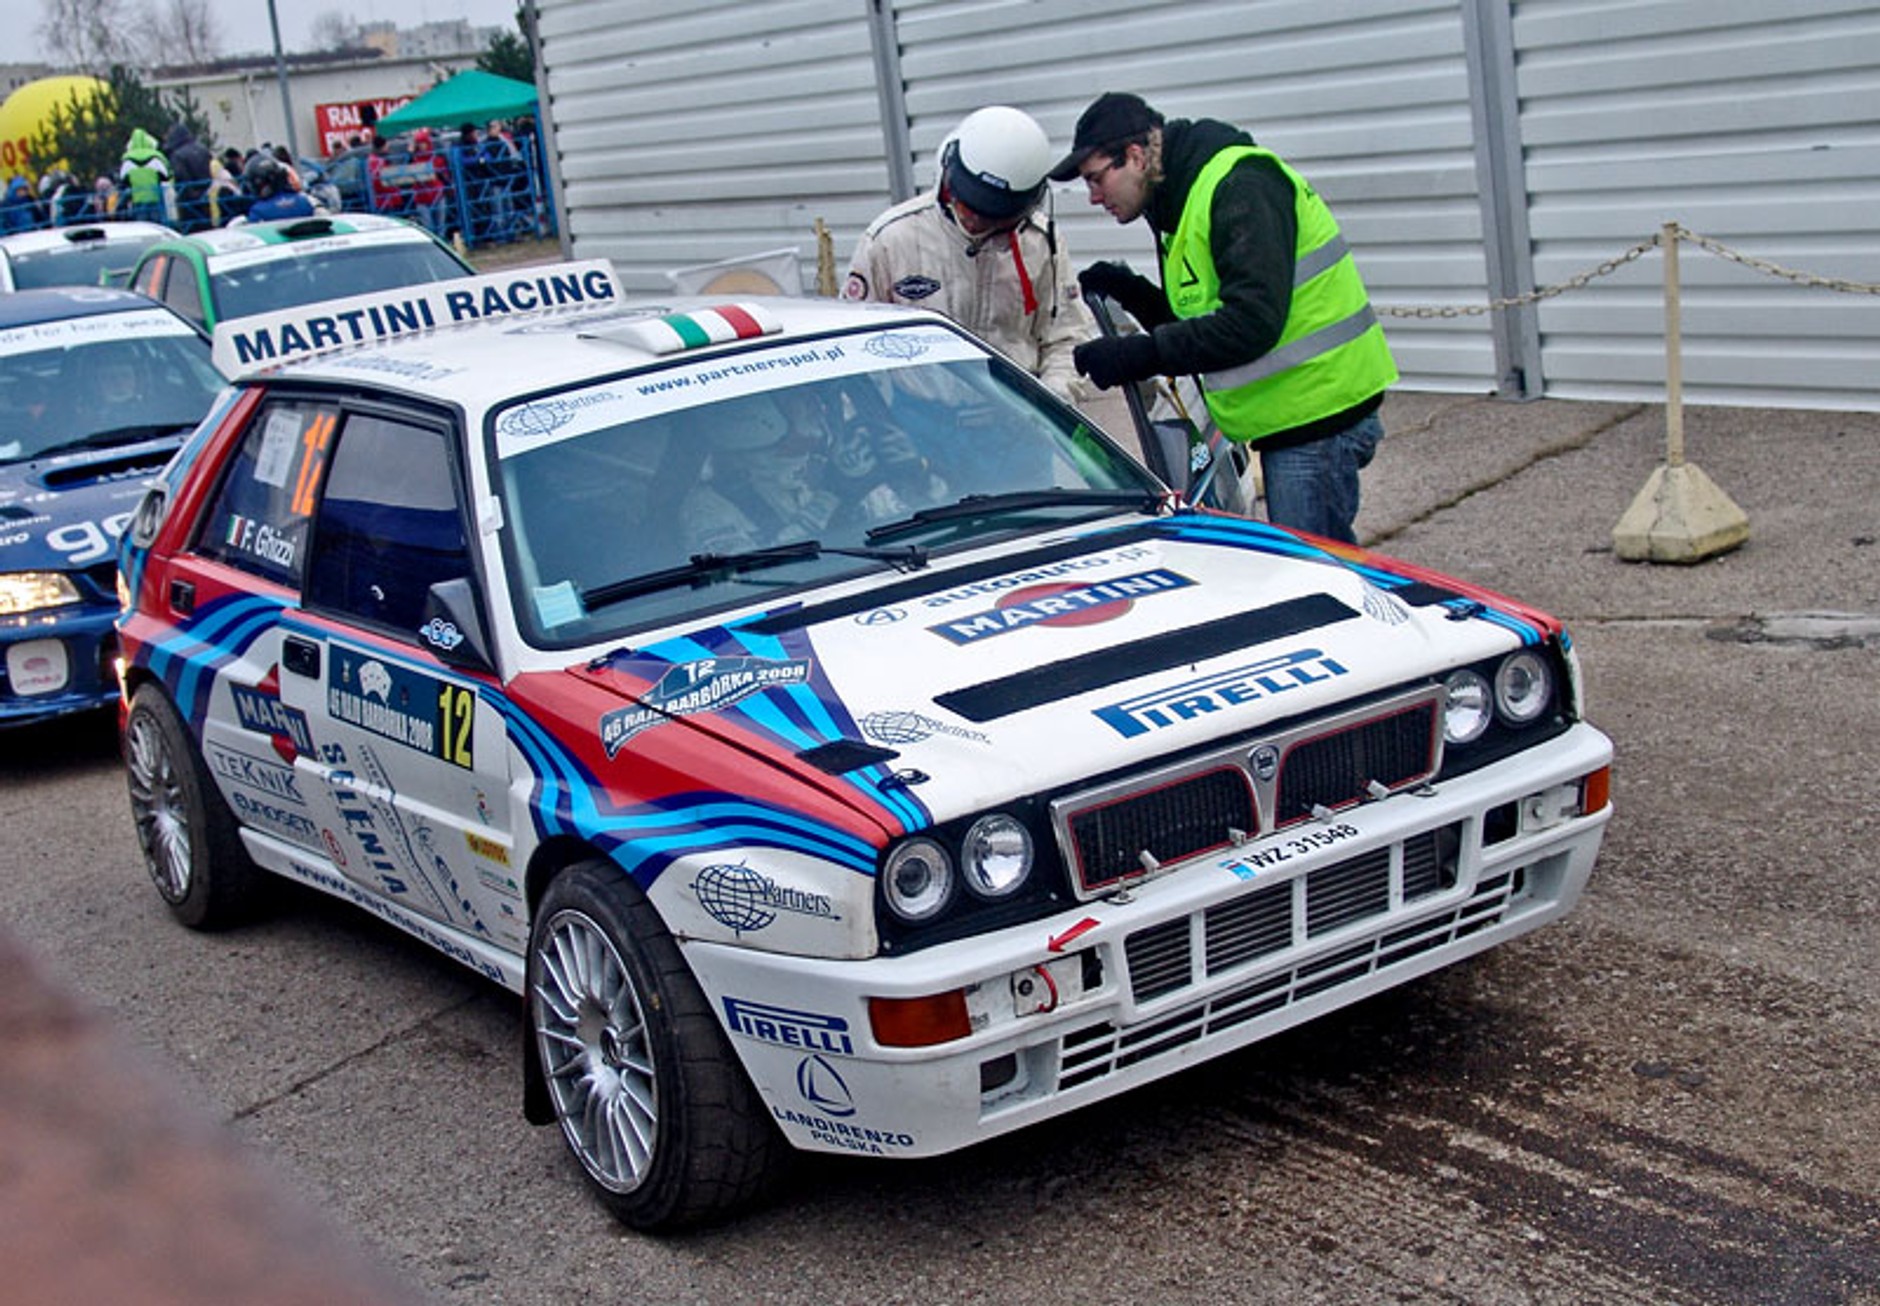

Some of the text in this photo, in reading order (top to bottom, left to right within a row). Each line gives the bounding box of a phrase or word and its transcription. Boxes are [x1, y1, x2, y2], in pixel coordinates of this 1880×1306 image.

[232, 270, 615, 364] MARTINI RACING
[636, 345, 846, 397] www.partnerspol.pl
[954, 573, 1176, 638] MARTINI
[683, 659, 716, 684] 12
[1091, 649, 1349, 738] PIRELLI
[439, 684, 472, 769] 12
[604, 717, 622, 743] 46
[214, 751, 304, 801] TEKNIK
[1243, 824, 1358, 868] WZ 31548
[763, 877, 832, 914] Partners
[722, 996, 853, 1055] PIRELLI
[773, 1106, 915, 1148] LANDIRENZO
[811, 1130, 884, 1155] POLSKA
